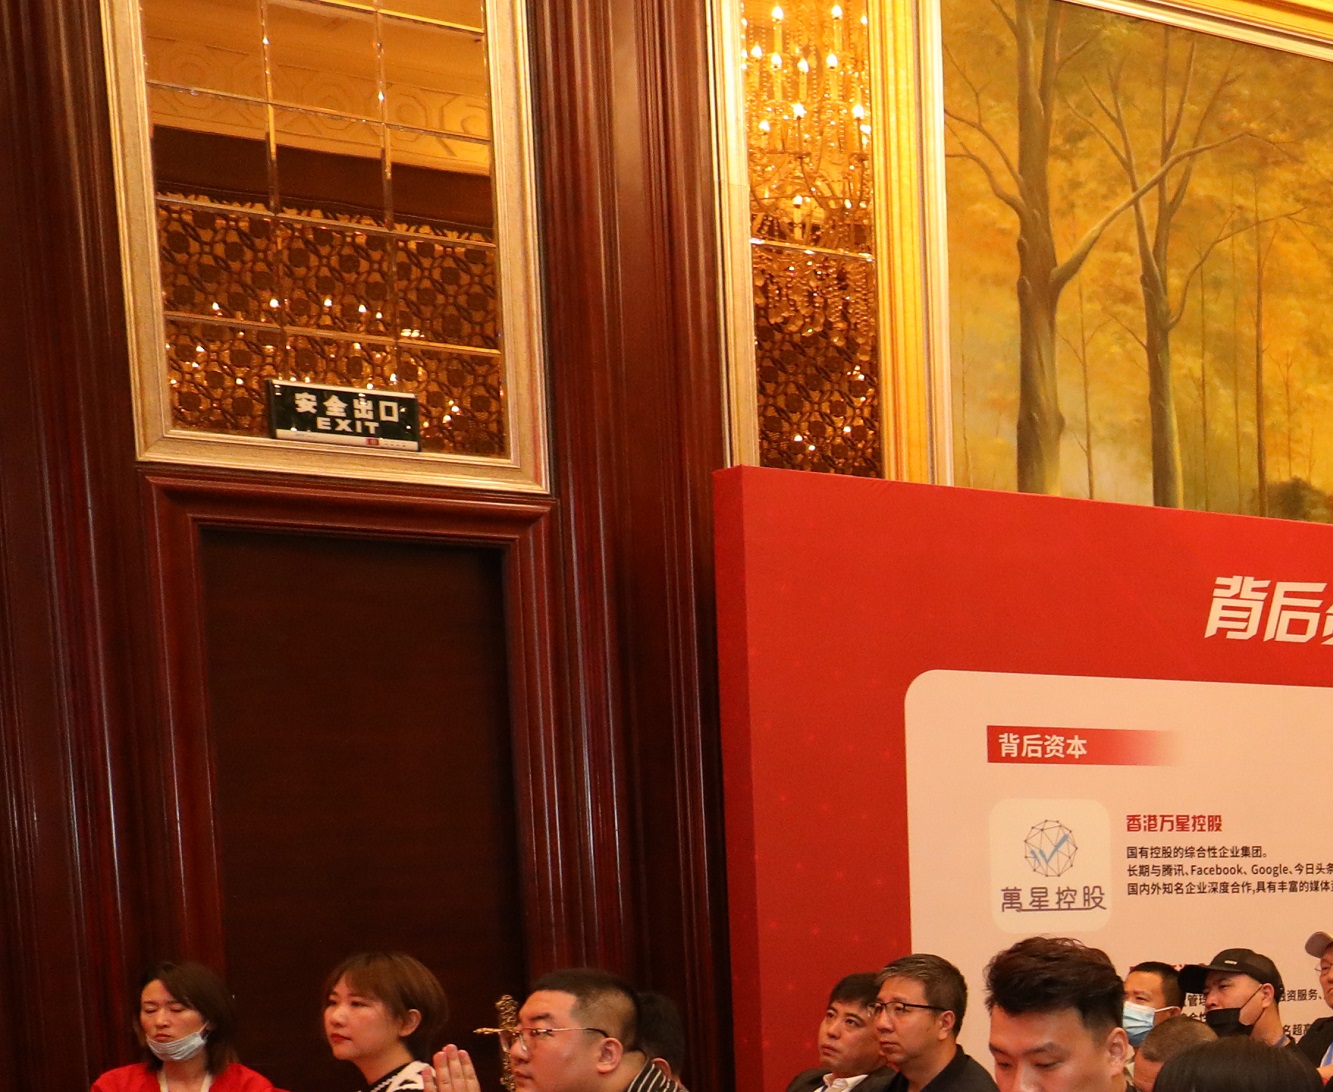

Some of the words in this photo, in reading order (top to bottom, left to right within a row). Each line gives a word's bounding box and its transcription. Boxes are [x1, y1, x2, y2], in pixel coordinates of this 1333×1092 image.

[294, 392, 400, 423] 安全出口
[316, 417, 380, 434] EXIT
[998, 733, 1088, 759] 背后资本
[1126, 814, 1223, 833] 香港万星控股
[1126, 846, 1267, 859] 国有控股的综合性企业集团。
[1000, 885, 1107, 913] 萬星控股
